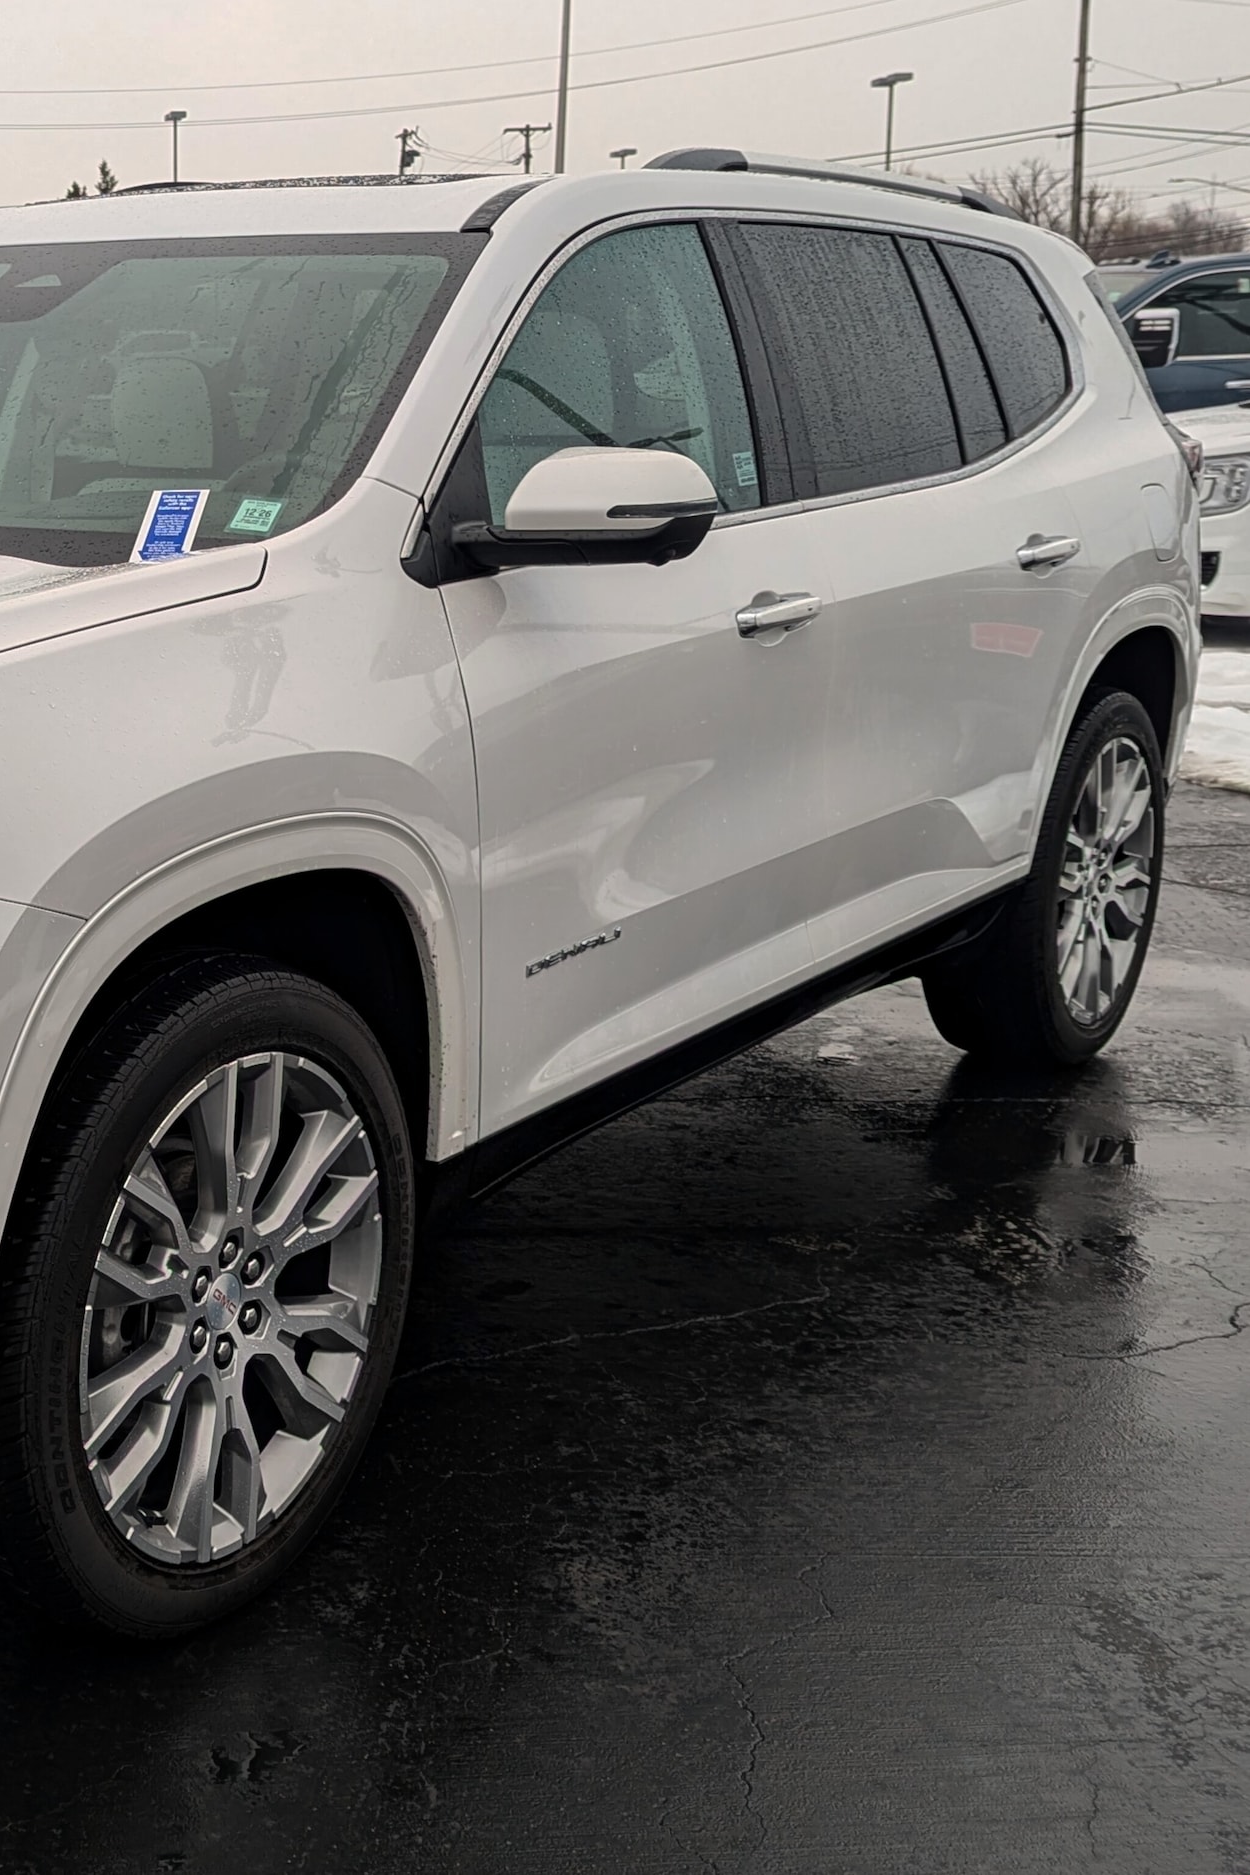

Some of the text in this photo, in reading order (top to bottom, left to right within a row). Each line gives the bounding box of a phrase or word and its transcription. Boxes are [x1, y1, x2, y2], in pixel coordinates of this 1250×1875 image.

[245, 507, 272, 518] 12 26
[213, 1288, 237, 1316] GMC
